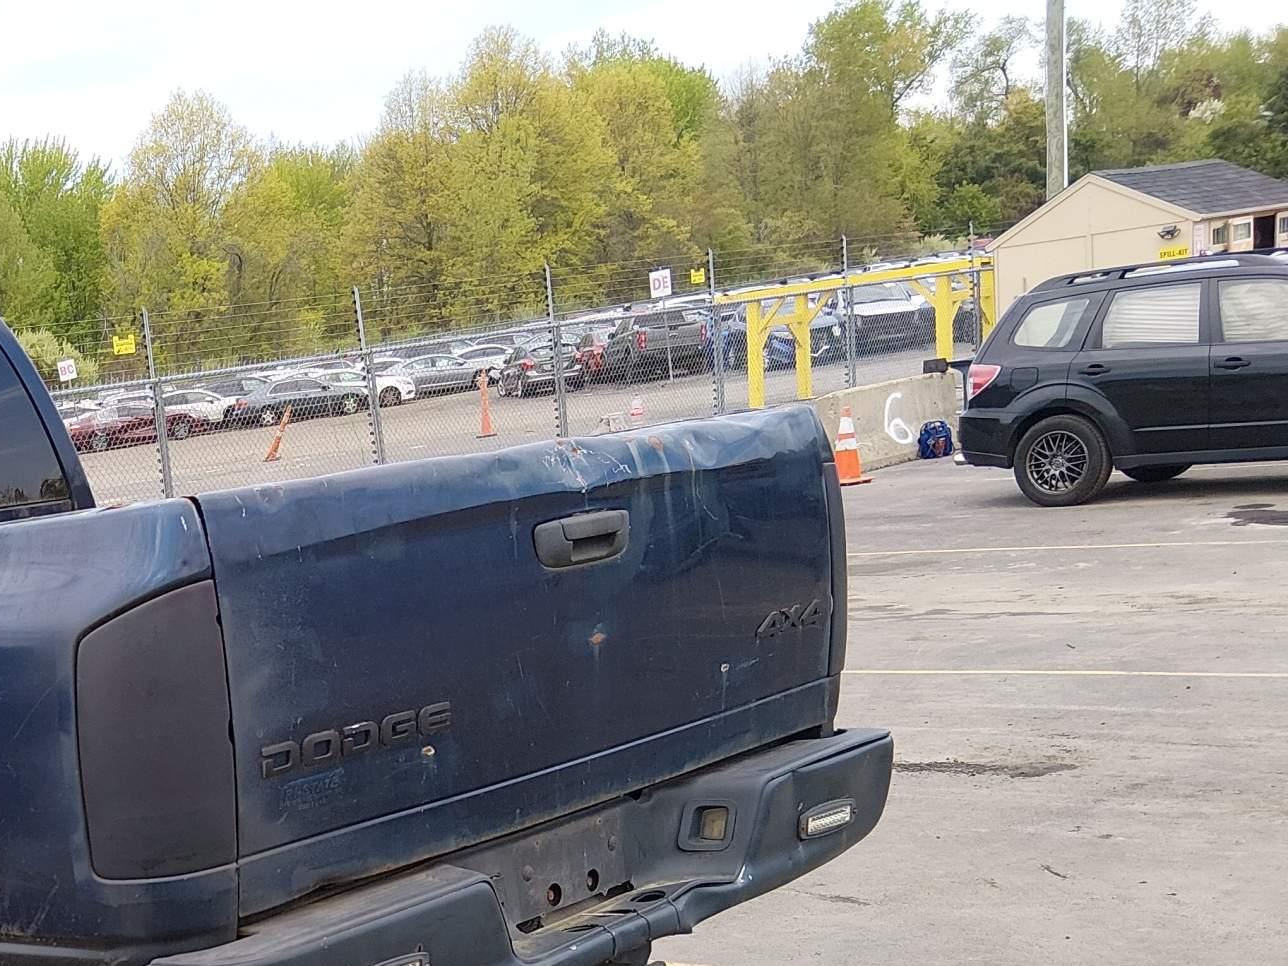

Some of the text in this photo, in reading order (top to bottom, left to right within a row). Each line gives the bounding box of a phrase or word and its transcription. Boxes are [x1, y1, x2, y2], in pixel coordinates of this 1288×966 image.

[653, 276, 669, 290] DE
[60, 364, 74, 375] BC
[884, 391, 913, 445] 6
[262, 701, 451, 779] DODGE
